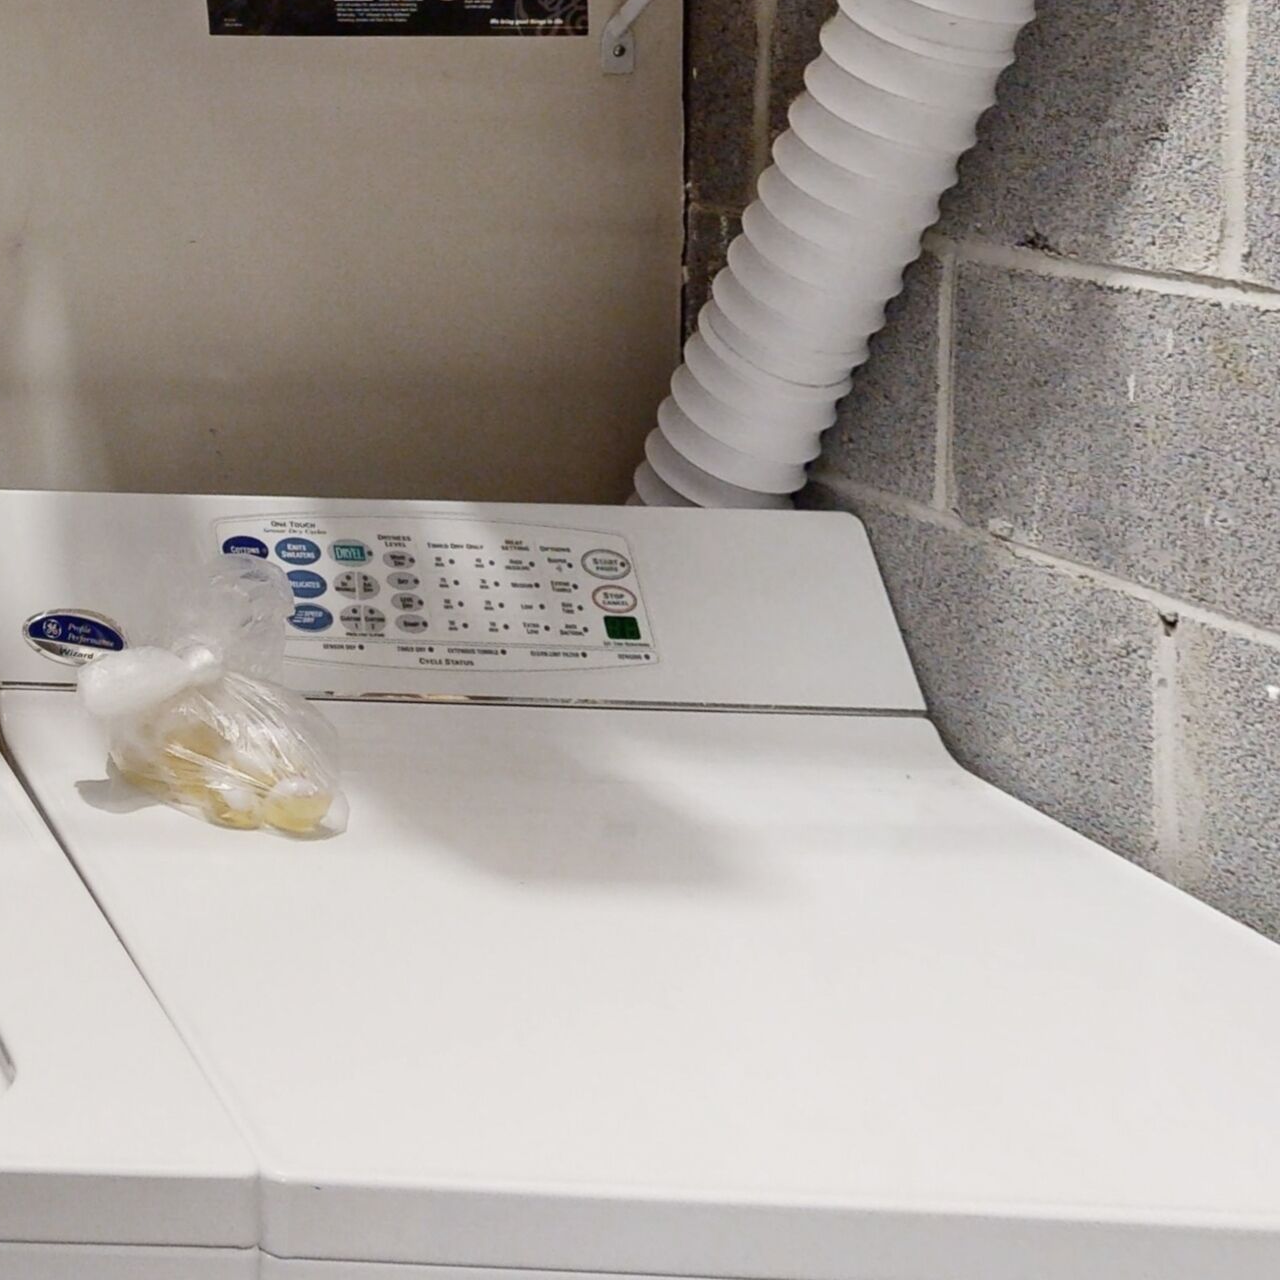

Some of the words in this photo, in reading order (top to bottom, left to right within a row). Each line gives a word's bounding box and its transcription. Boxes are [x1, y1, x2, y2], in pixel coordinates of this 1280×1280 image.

[289, 521, 316, 529] TOUCH
[287, 544, 307, 552] KNITS
[539, 545, 571, 553] OPTIONS
[281, 551, 316, 559] SWEATERS
[335, 546, 365, 560] DRYEL
[67, 623, 91, 633] Profile
[67, 632, 115, 647] Performance
[58, 648, 95, 660] Wizard
[419, 657, 443, 665] CYCLE
[444, 658, 474, 666] STATUS
